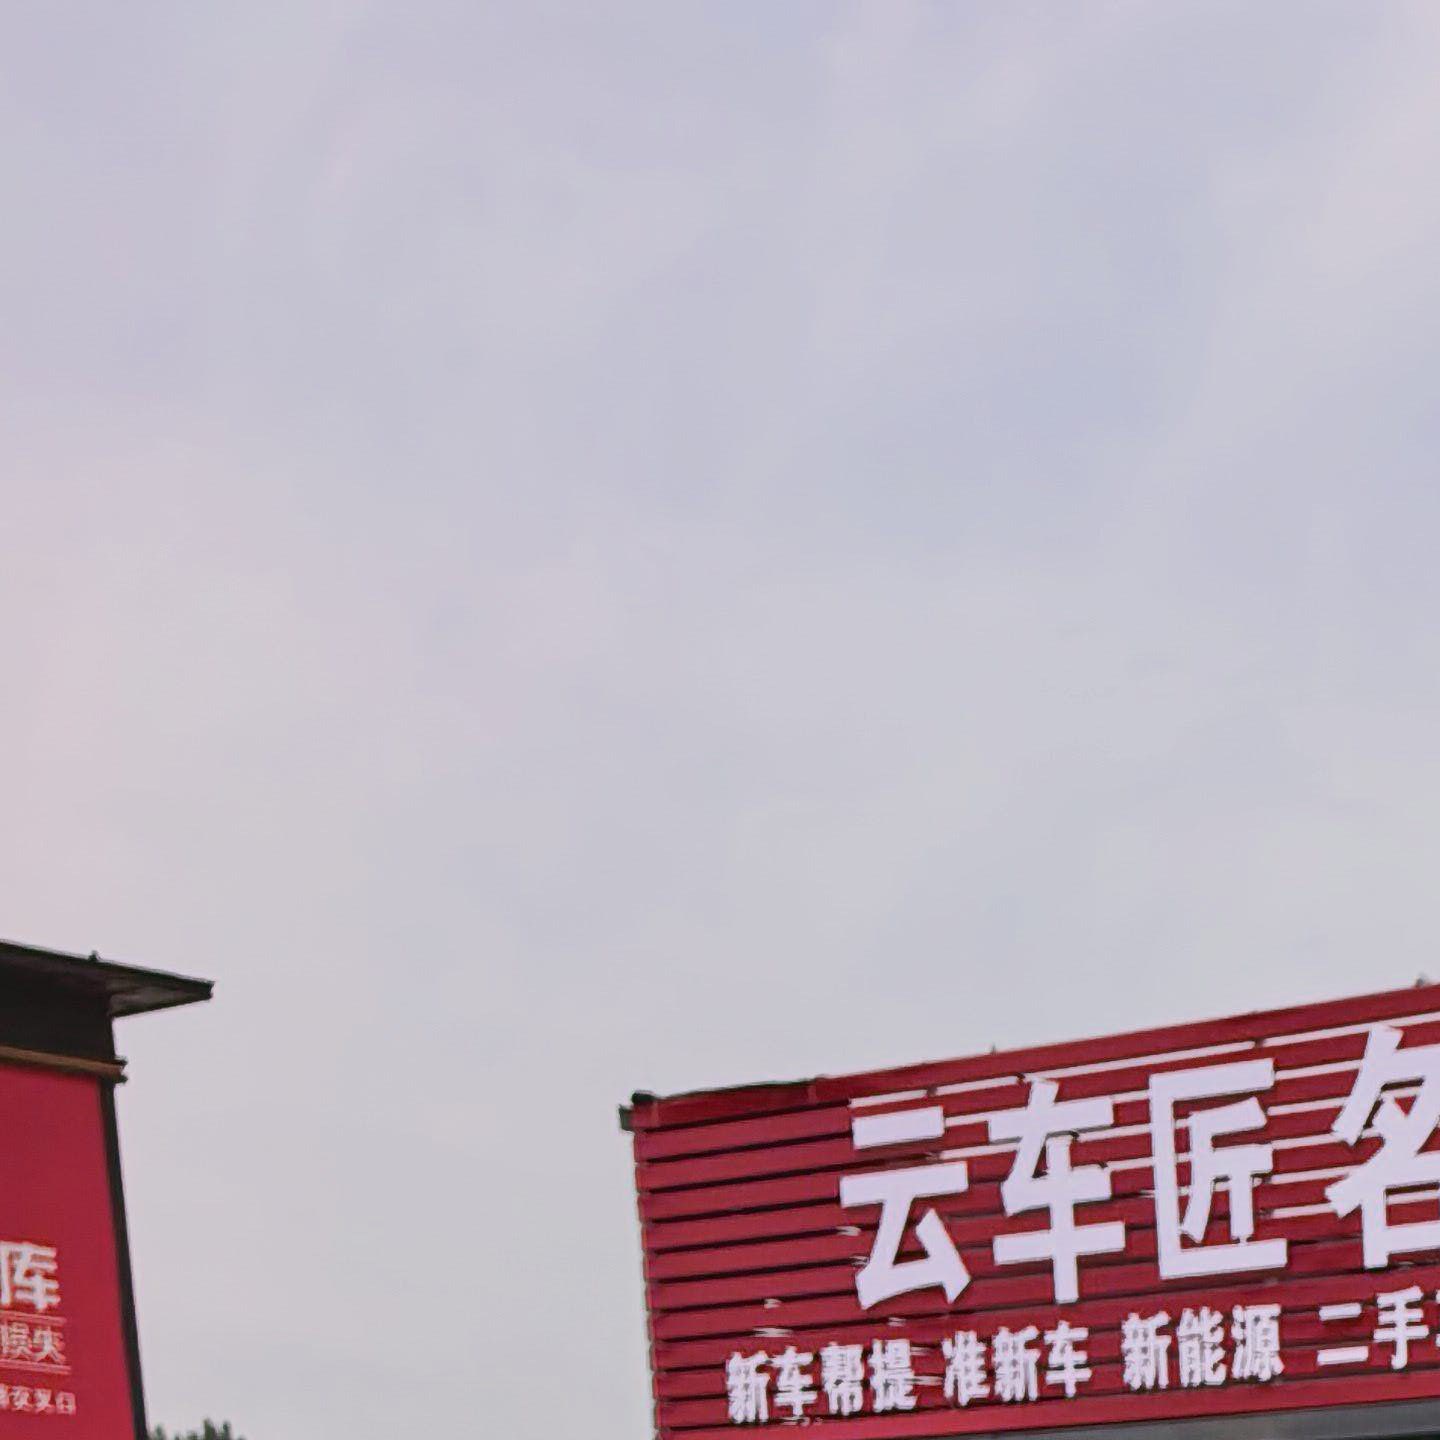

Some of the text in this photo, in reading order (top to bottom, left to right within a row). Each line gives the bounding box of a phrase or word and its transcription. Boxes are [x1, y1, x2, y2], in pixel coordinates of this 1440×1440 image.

[940, 1319, 1093, 1407] 准新车
[1120, 1303, 1285, 1392] 新能源
